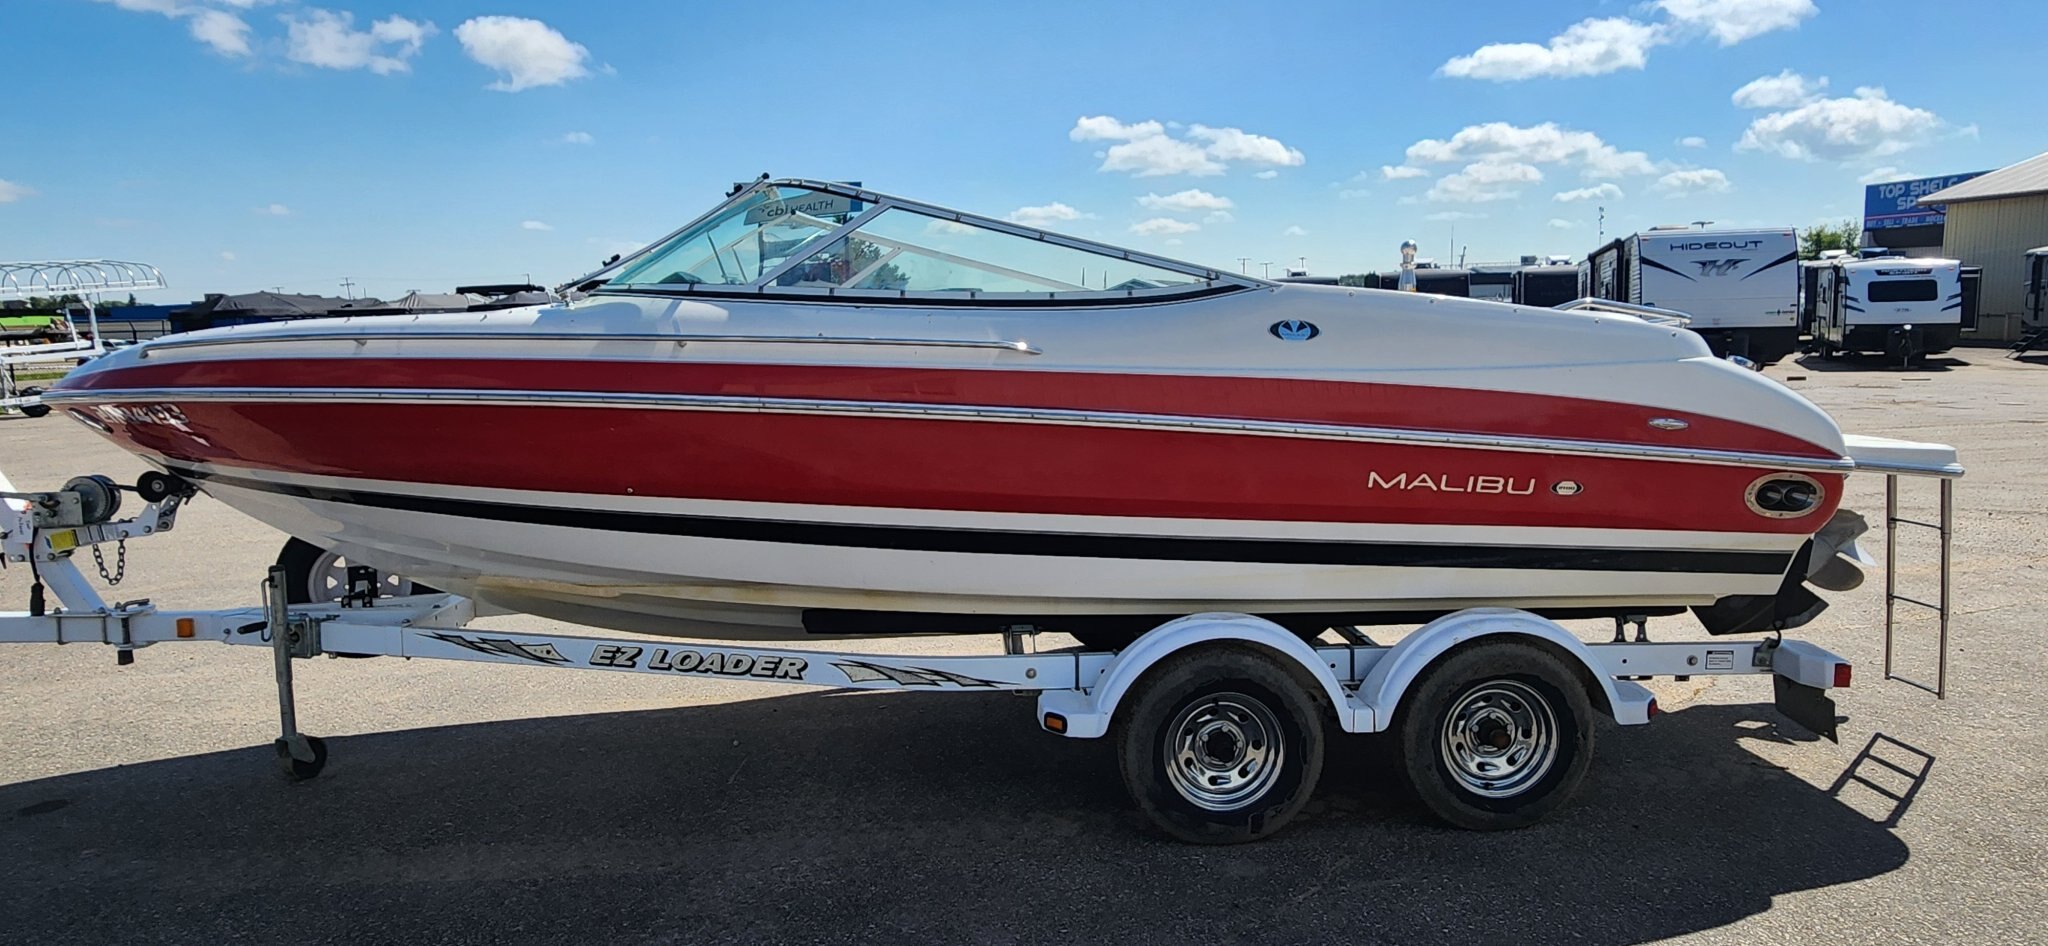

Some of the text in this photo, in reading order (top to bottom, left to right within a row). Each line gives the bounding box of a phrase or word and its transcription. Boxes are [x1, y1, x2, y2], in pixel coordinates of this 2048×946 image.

[1879, 183, 1905, 199] TOP
[791, 199, 833, 213] HEALTH
[1670, 240, 1763, 251] HIDEOUT
[1368, 471, 1536, 495] MALIBU
[588, 644, 808, 680] EZ LOADER
